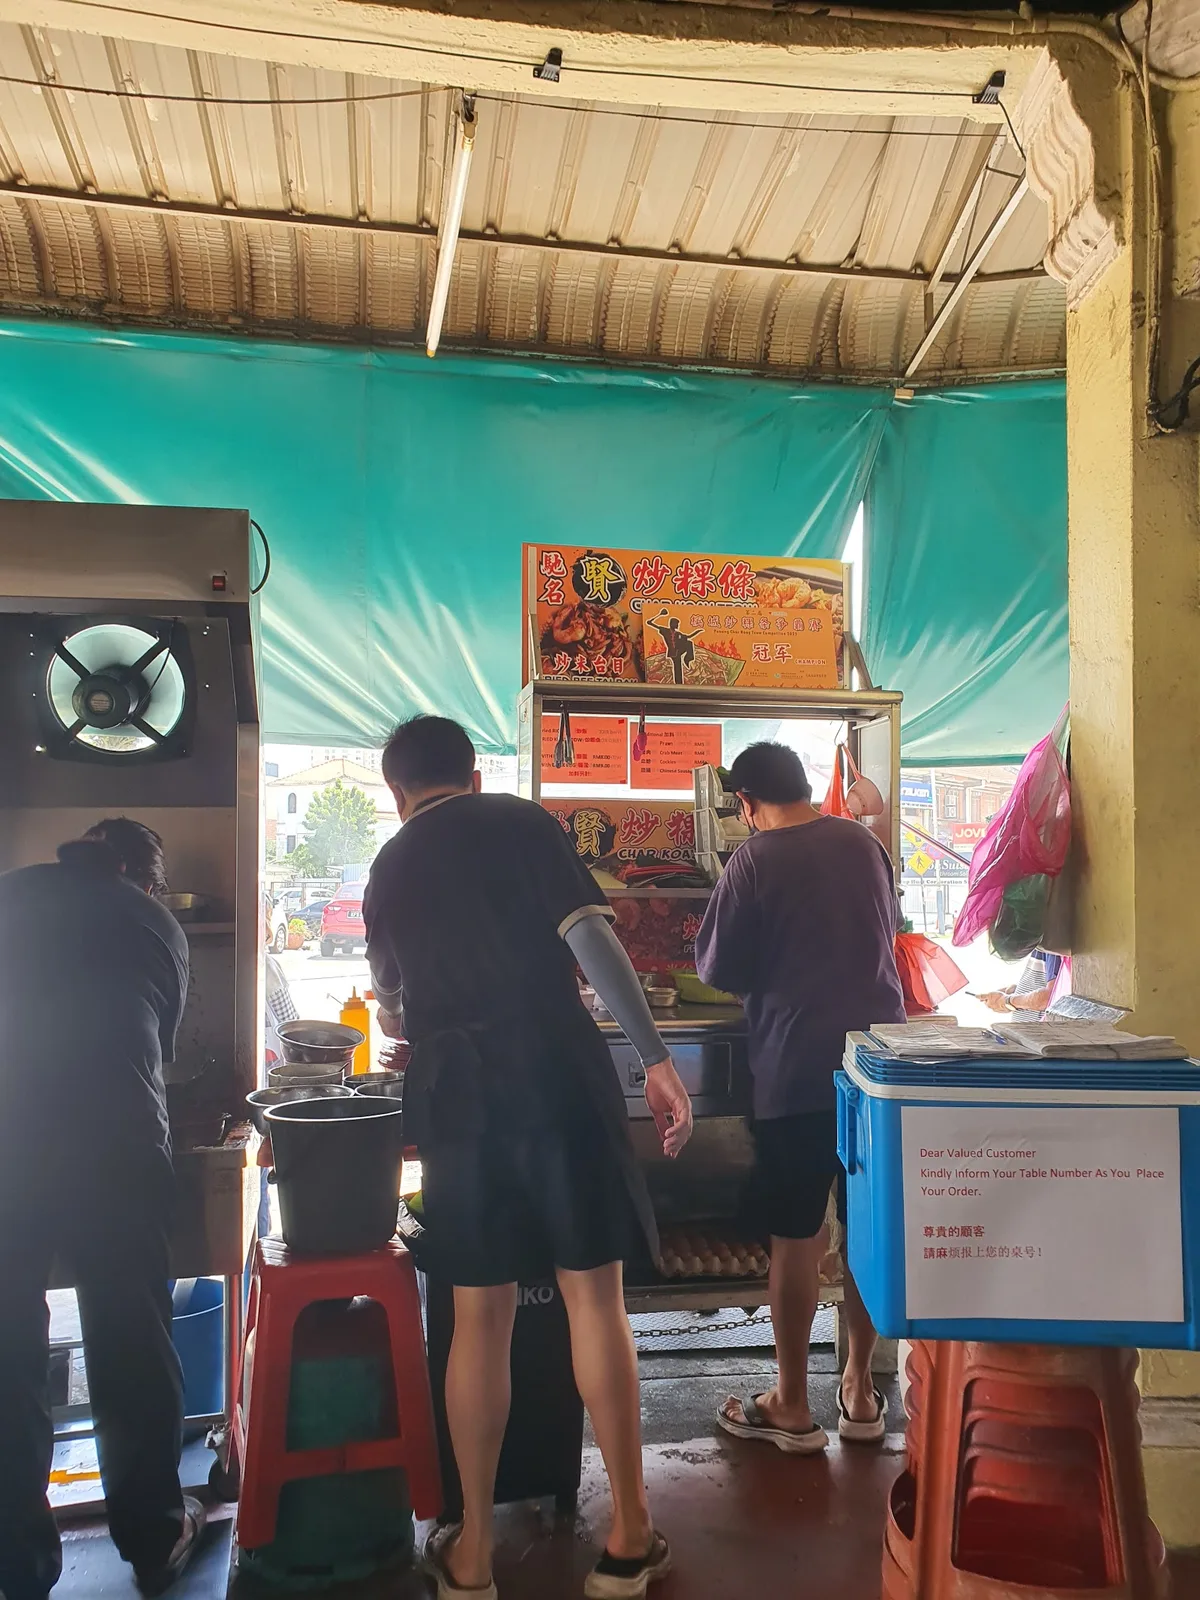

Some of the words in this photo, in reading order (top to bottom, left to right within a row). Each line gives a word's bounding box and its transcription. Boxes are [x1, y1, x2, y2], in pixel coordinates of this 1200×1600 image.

[580, 556, 625, 603] 賢
[632, 556, 757, 600] 炒粿條
[752, 642, 792, 664] 冠军
[574, 810, 605, 858] 賢
[920, 1148, 944, 1158] Dear
[946, 1148, 983, 1158] Valued
[986, 1148, 1036, 1158] Customer
[920, 1168, 952, 1180] Kindly
[955, 1168, 990, 1178] Inform
[992, 1169, 1017, 1178] Your
[1019, 1168, 1047, 1178] Table
[1050, 1168, 1092, 1178] Number
[1095, 1168, 1108, 1178] As
[1110, 1168, 1130, 1178] You
[1136, 1168, 1164, 1178] Place
[921, 1186, 945, 1196] Your
[948, 1186, 981, 1196] Order.
